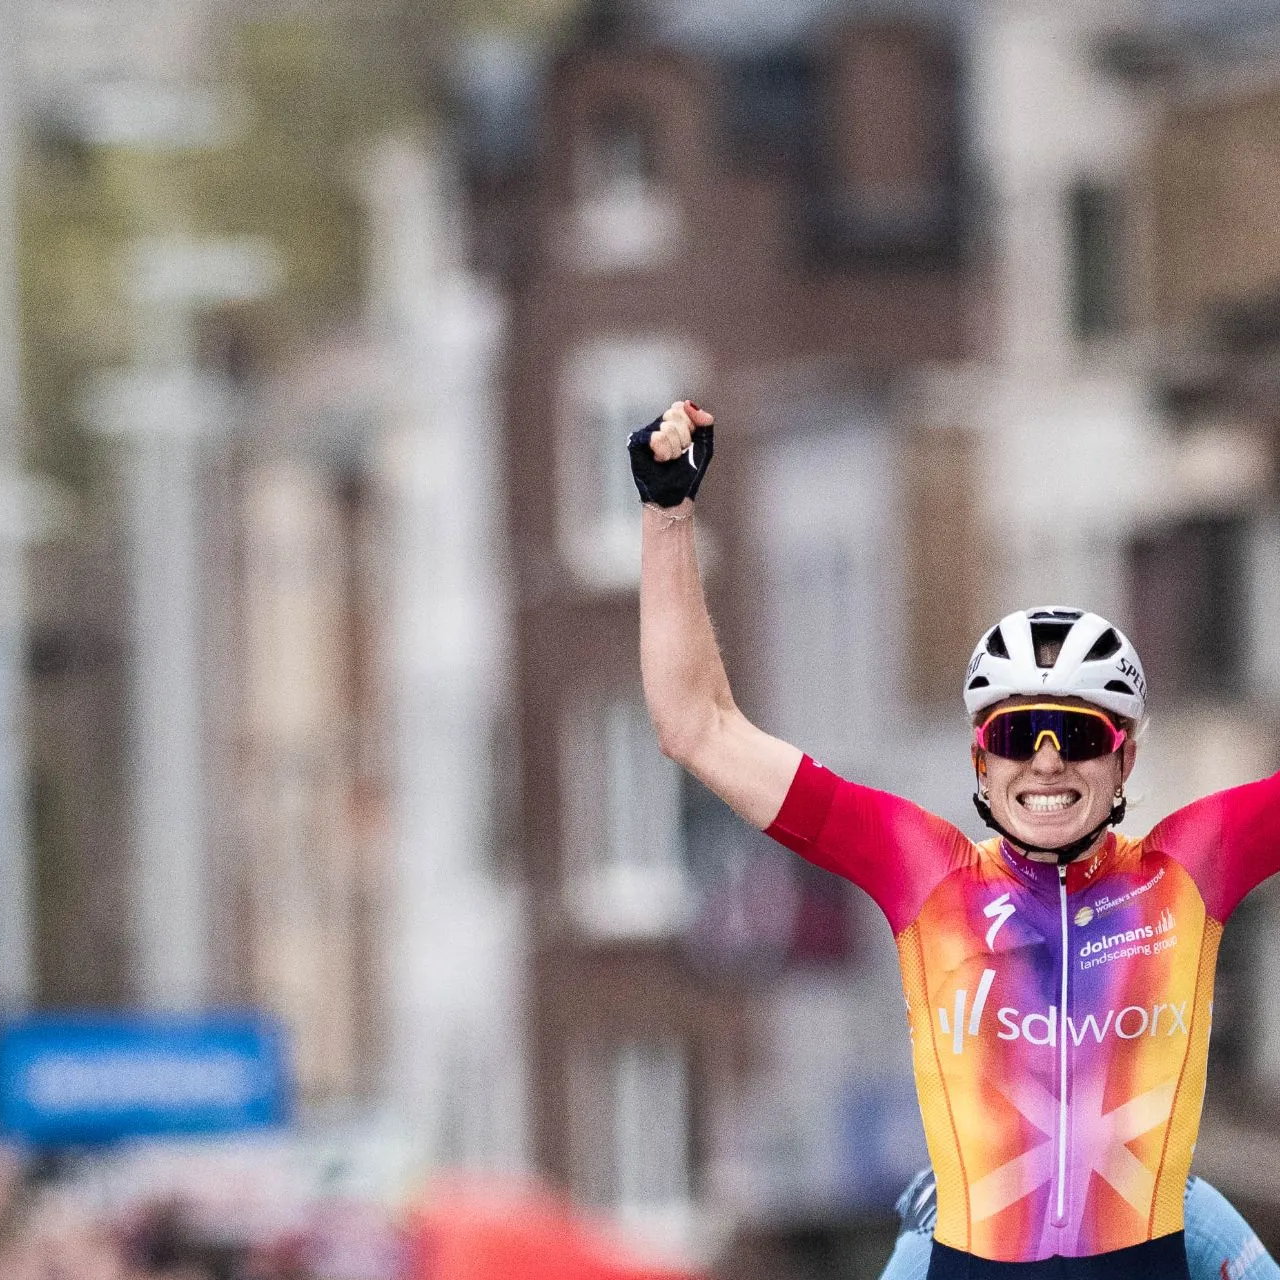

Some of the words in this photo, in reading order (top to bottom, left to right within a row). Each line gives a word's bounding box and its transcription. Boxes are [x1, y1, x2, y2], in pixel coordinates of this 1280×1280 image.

[1094, 896, 1110, 908] UCI
[1080, 925, 1154, 957] dolmans
[1080, 944, 1152, 970] landscaping
[1153, 935, 1178, 955] group
